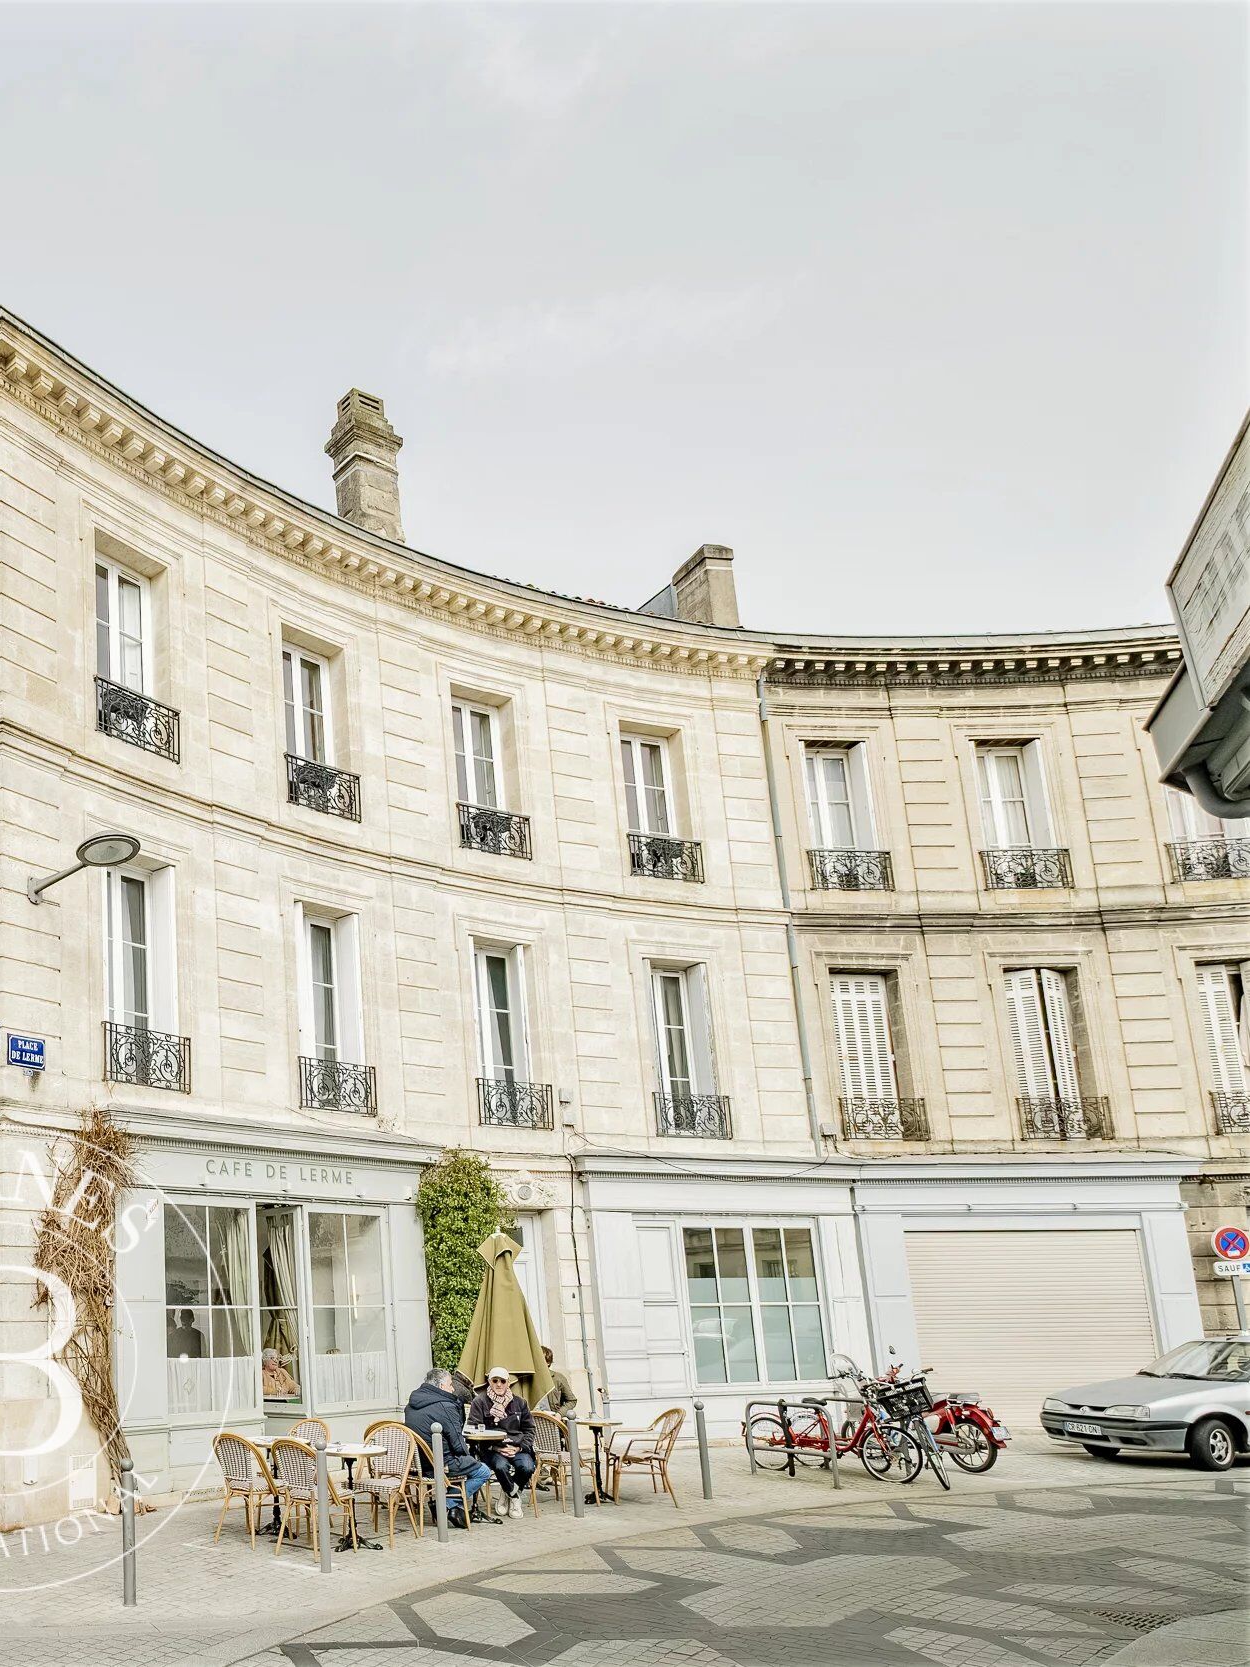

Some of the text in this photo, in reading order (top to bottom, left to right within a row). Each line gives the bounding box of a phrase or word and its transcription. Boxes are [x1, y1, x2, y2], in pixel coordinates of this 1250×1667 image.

[17, 1040, 38, 1051] PLACE
[11, 1050, 44, 1064] DE LERME
[206, 1159, 352, 1185] CAFÉ DE LERME
